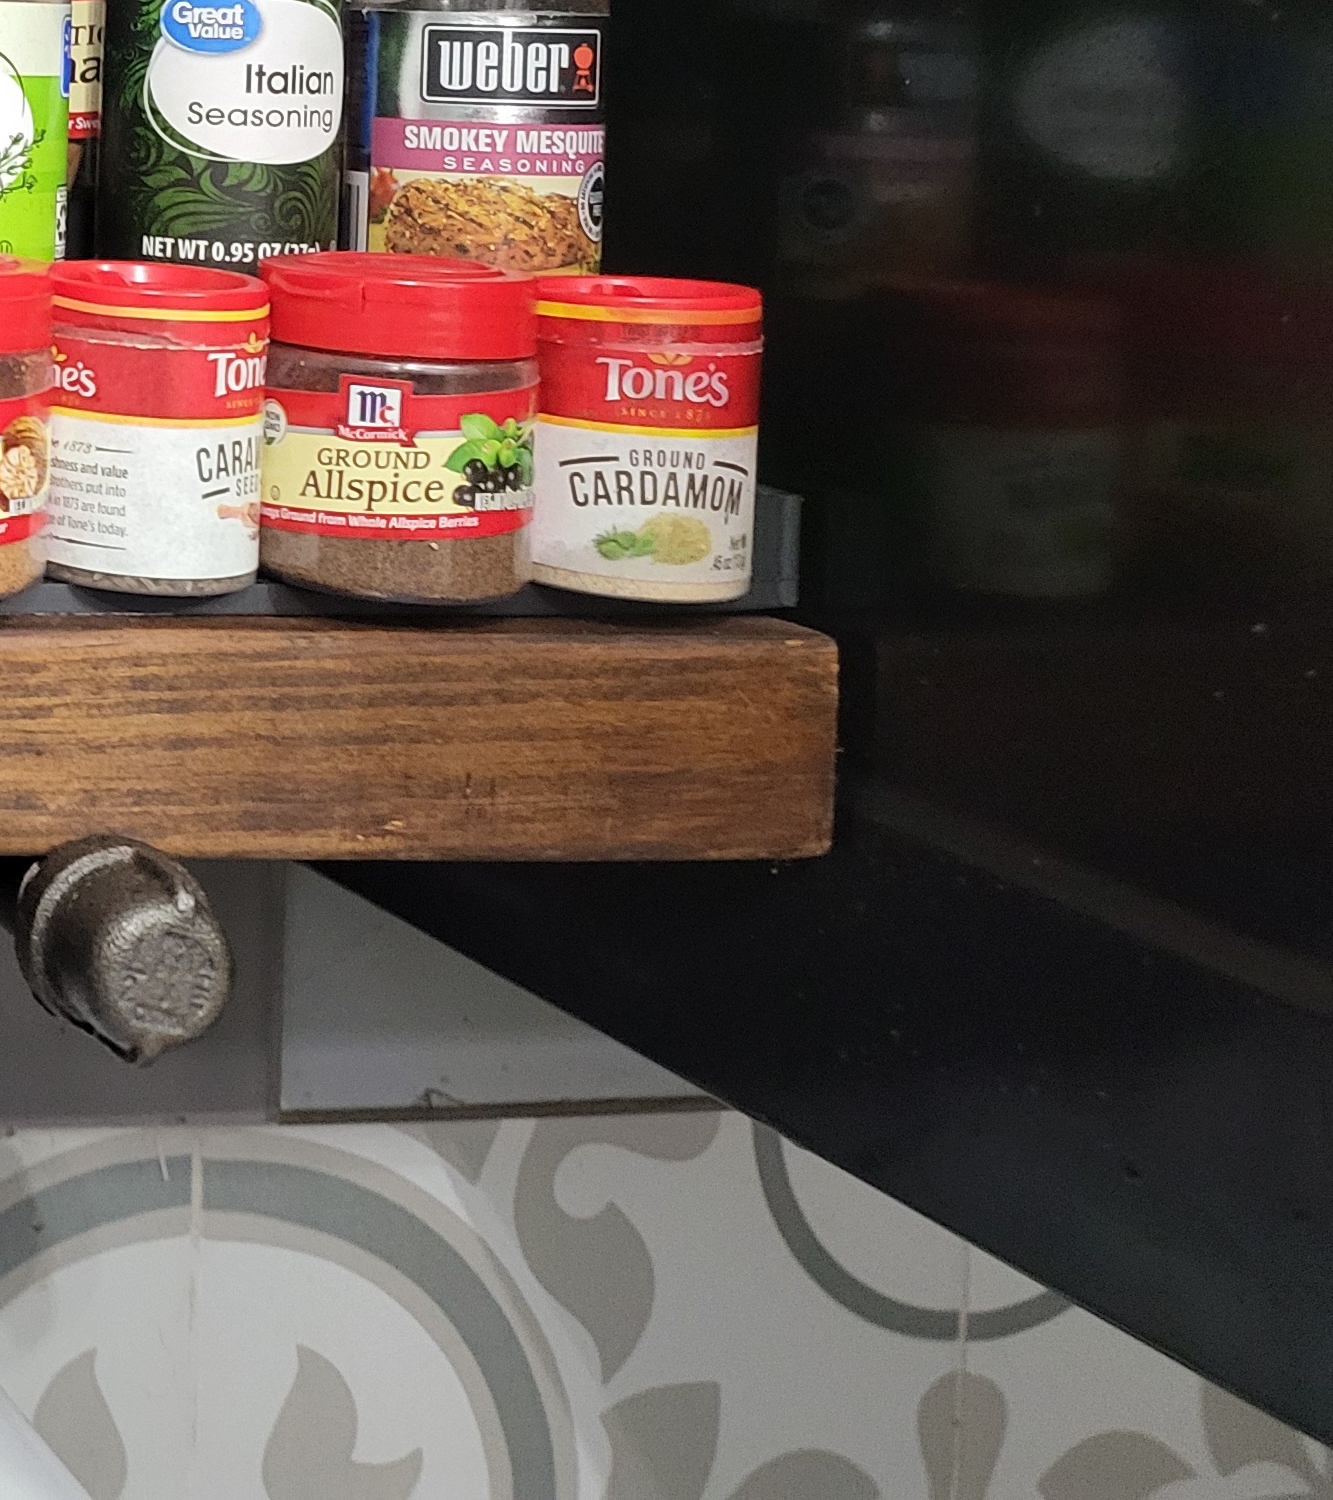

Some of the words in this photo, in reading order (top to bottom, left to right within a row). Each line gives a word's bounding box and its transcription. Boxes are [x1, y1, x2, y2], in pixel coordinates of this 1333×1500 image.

[172, 2, 244, 26] Great
[188, 22, 244, 41] Value
[437, 32, 569, 93] weber
[245, 63, 334, 96] Italian
[187, 101, 333, 133] Seasoning
[404, 125, 508, 152] SMOKEY
[516, 129, 605, 157] MESQUITE
[443, 156, 584, 174] SEASONING
[142, 235, 175, 257] NET
[178, 238, 209, 261] WT
[212, 240, 255, 263] 0.95
[596, 357, 730, 407] Tone's
[337, 425, 408, 441] McCormick
[317, 448, 431, 469] GROUND
[629, 449, 706, 470] GROUND
[80, 463, 98, 475] and
[101, 464, 128, 479] value
[86, 483, 103, 495] put
[106, 483, 126, 497] into
[299, 470, 444, 511] Allspice
[569, 470, 743, 516] CARDAMOM
[81, 501, 95, 513] are
[98, 502, 126, 516] found
[281, 508, 316, 524] Ground
[318, 513, 346, 527] from
[348, 515, 386, 529] Whole
[389, 516, 436, 531] Allspice
[438, 515, 479, 529] Berries
